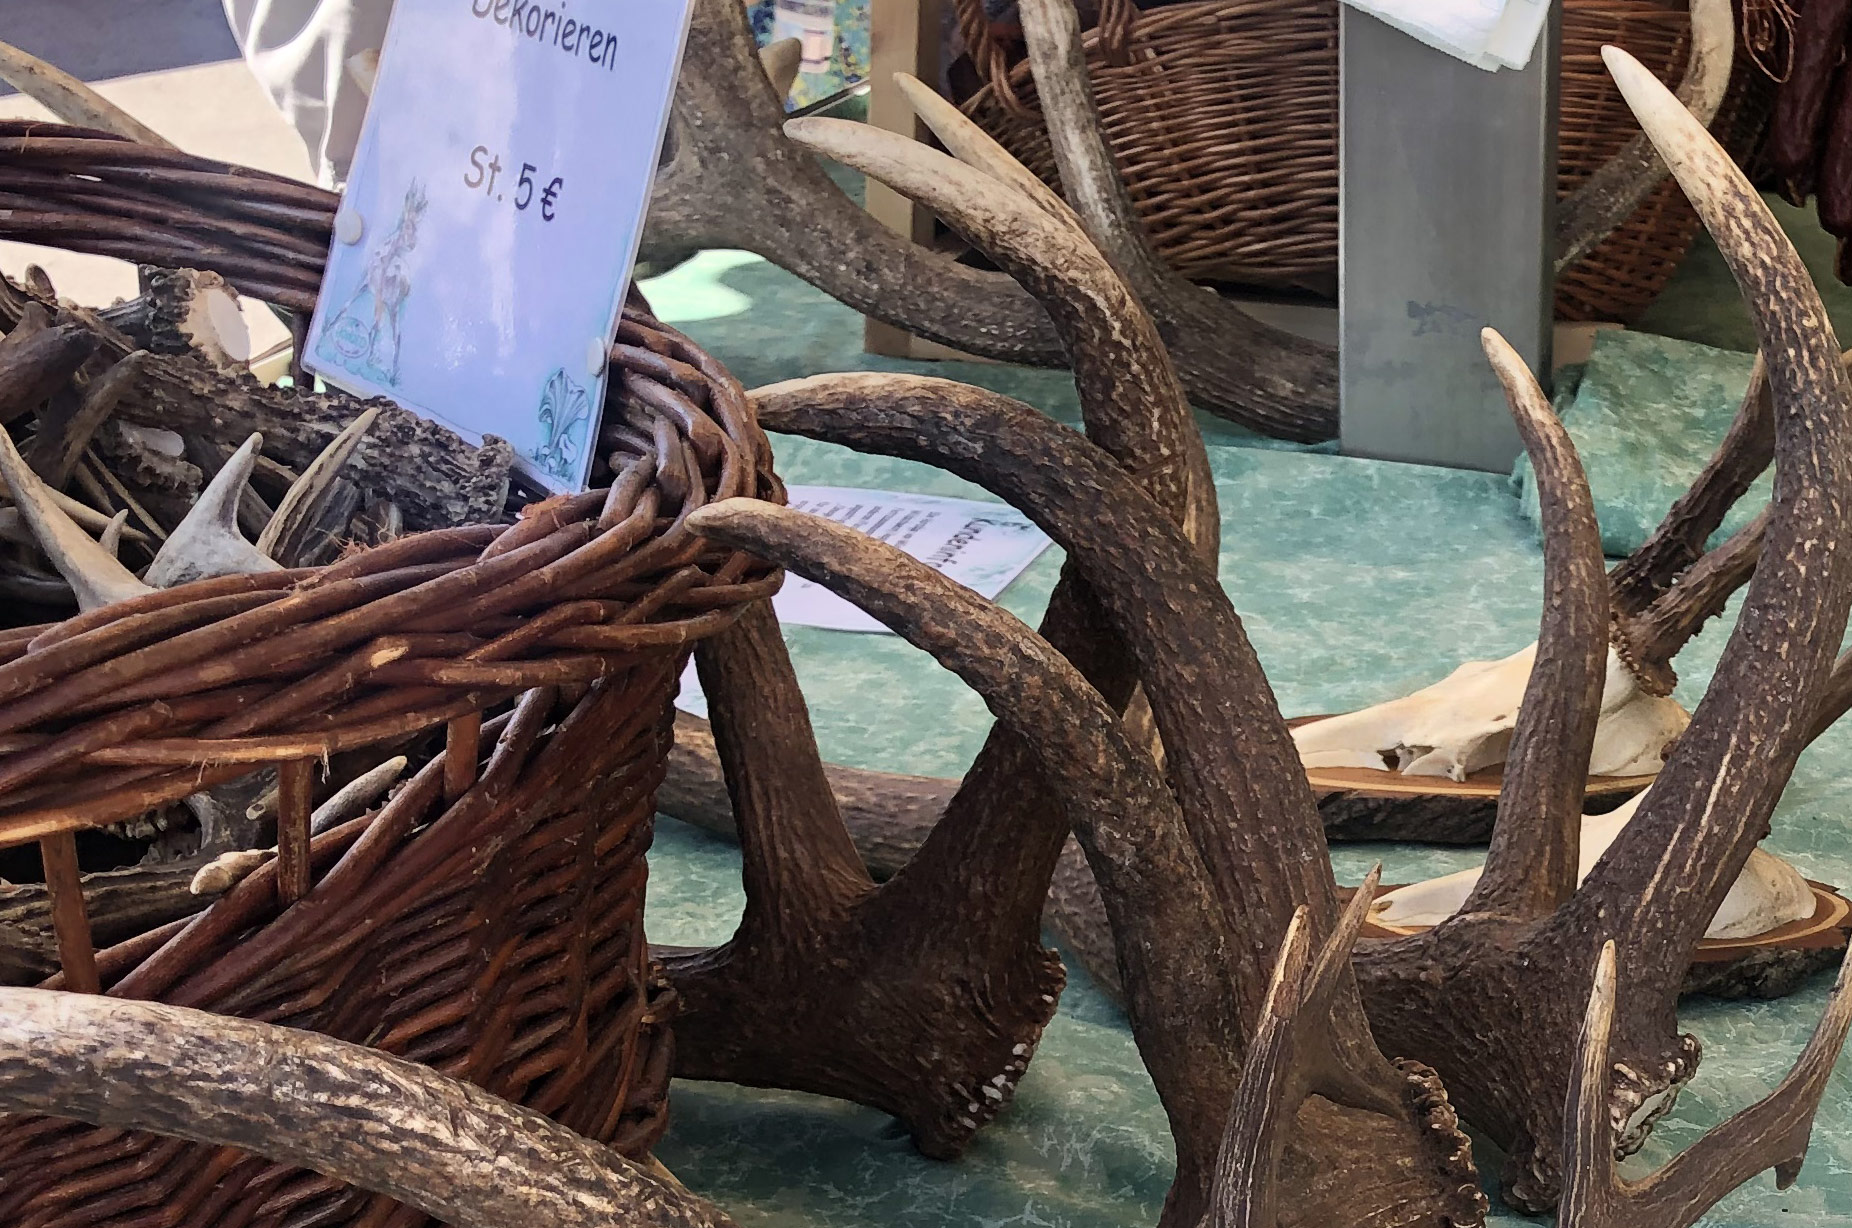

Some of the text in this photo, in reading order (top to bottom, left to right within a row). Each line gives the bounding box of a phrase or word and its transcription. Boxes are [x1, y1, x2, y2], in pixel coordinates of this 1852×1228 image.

[463, 145, 564, 222] St. 5 €
